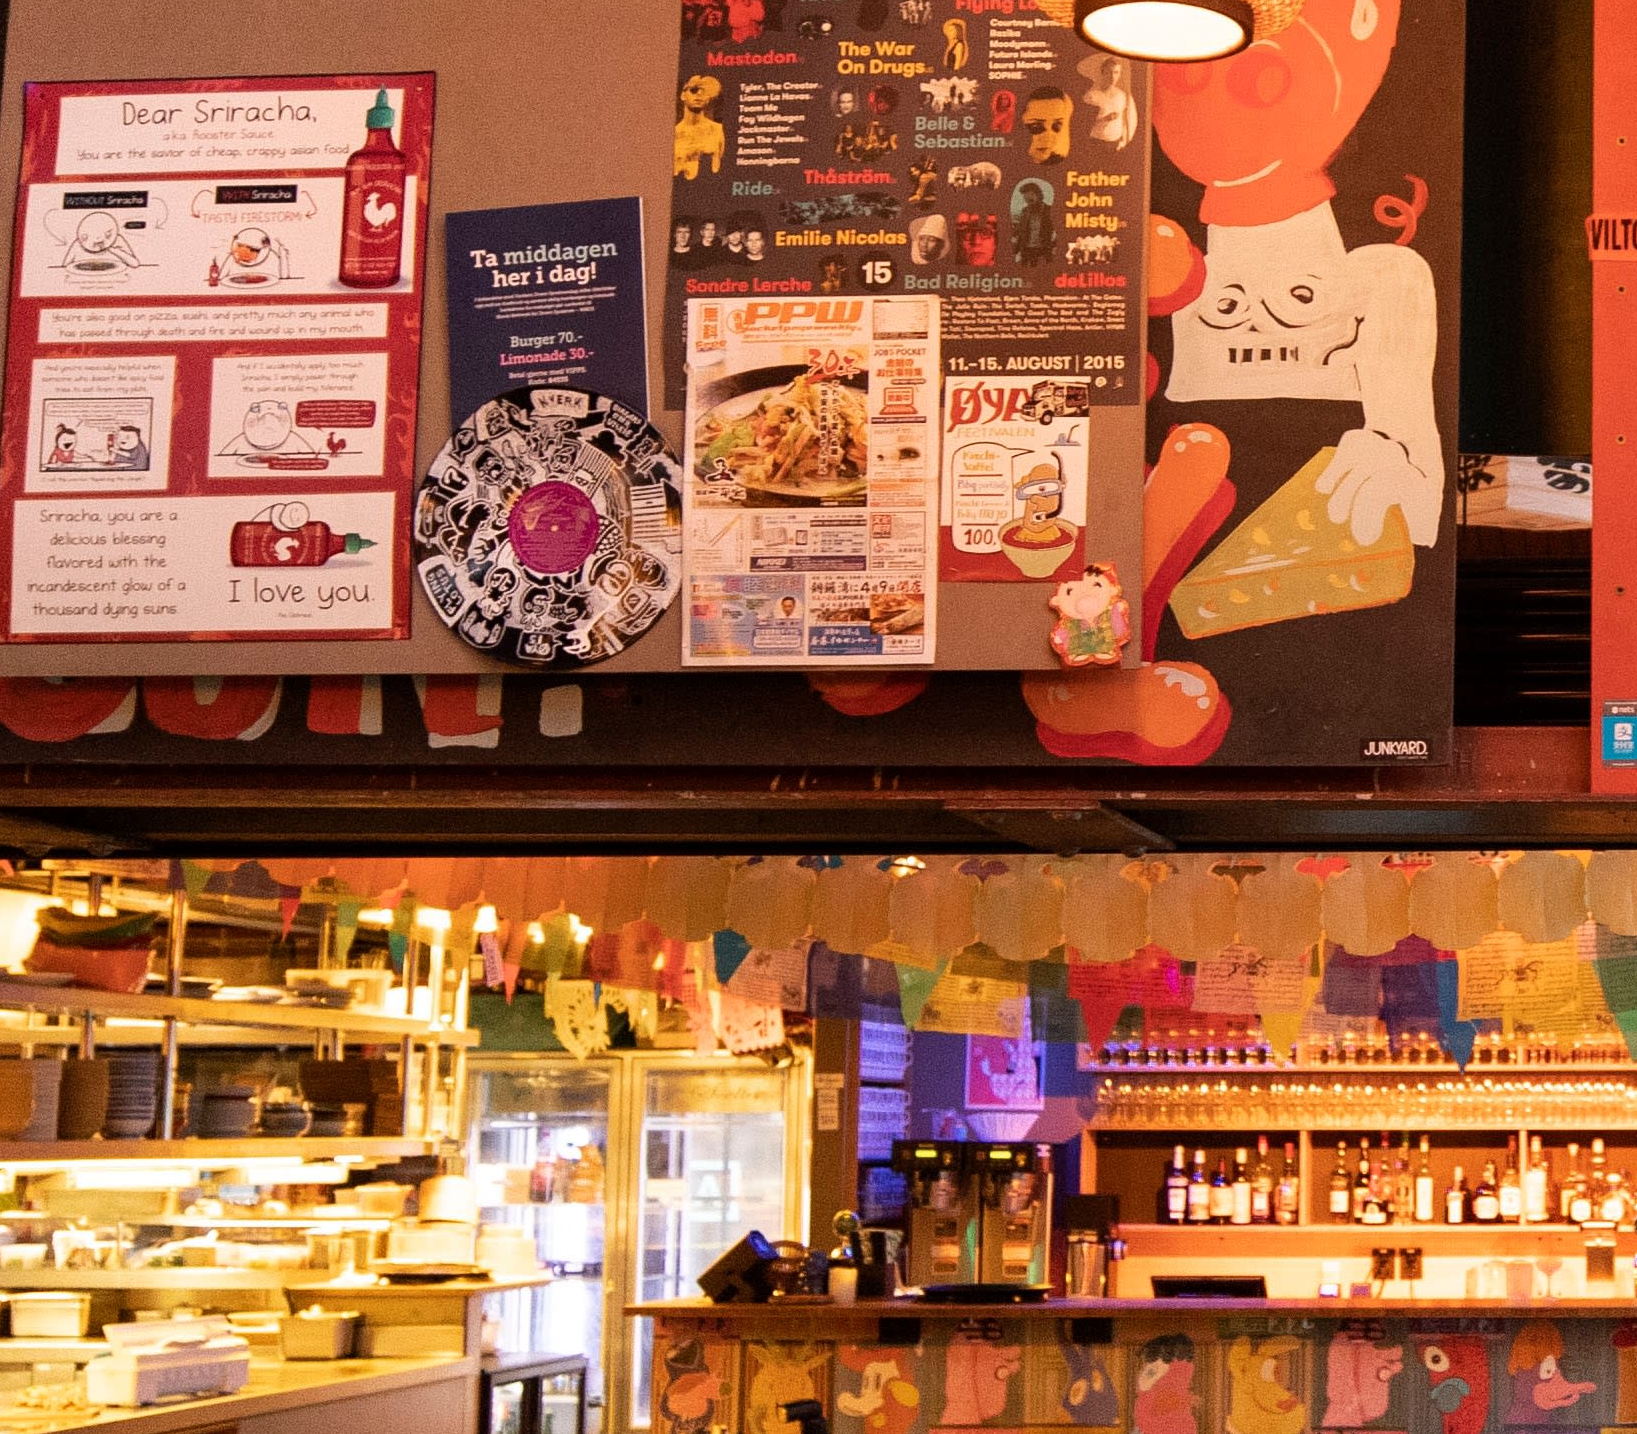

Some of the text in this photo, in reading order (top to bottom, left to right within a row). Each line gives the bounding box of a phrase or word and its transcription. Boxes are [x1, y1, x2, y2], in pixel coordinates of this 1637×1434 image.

[838, 41, 915, 56] The War
[706, 50, 798, 67] Mastodon
[837, 59, 925, 78] On Drugs
[122, 98, 318, 126] Dear Sriracha,
[915, 116, 975, 130] Belle &
[192, 128, 237, 141] Rooster
[240, 128, 274, 140] Sauce
[914, 134, 1005, 148] Sebastian
[77, 148, 102, 162] You
[104, 149, 124, 159] are
[129, 147, 147, 158] the
[190, 146, 205, 157] of
[246, 146, 287, 160] crappy
[290, 146, 319, 157] asian
[803, 168, 890, 184] Thåström
[1066, 171, 1130, 187] Father
[252, 188, 294, 200] Sriracha
[732, 182, 773, 196] Ride
[106, 193, 145, 206] Sriracha
[1066, 192, 1112, 208] John
[201, 211, 237, 224] TASTY
[1065, 214, 1118, 232] Misty
[775, 230, 907, 247] Emilie Nicolas
[470, 241, 618, 268] Ta middagen
[492, 262, 597, 287] her i dag!
[862, 261, 892, 284] 15
[686, 277, 811, 293] Sondre Lerche
[904, 274, 1023, 292] Bad Religion
[744, 301, 864, 324] PPW
[510, 331, 583, 348] Burger 70.-
[499, 347, 594, 366] Limonade 30.-
[895, 347, 926, 356] POCKET
[1006, 355, 1071, 370] AUGUST
[1083, 355, 1125, 370] 2015
[107, 510, 135, 525] you
[138, 511, 163, 523] are
[167, 511, 178, 522] a
[49, 532, 166, 548] delicious blessing
[47, 553, 167, 569] flavored with the
[27, 578, 187, 594] incandescent glow of a
[228, 578, 376, 610] I love you.
[33, 602, 98, 616] thousand
[102, 602, 138, 618] dying
